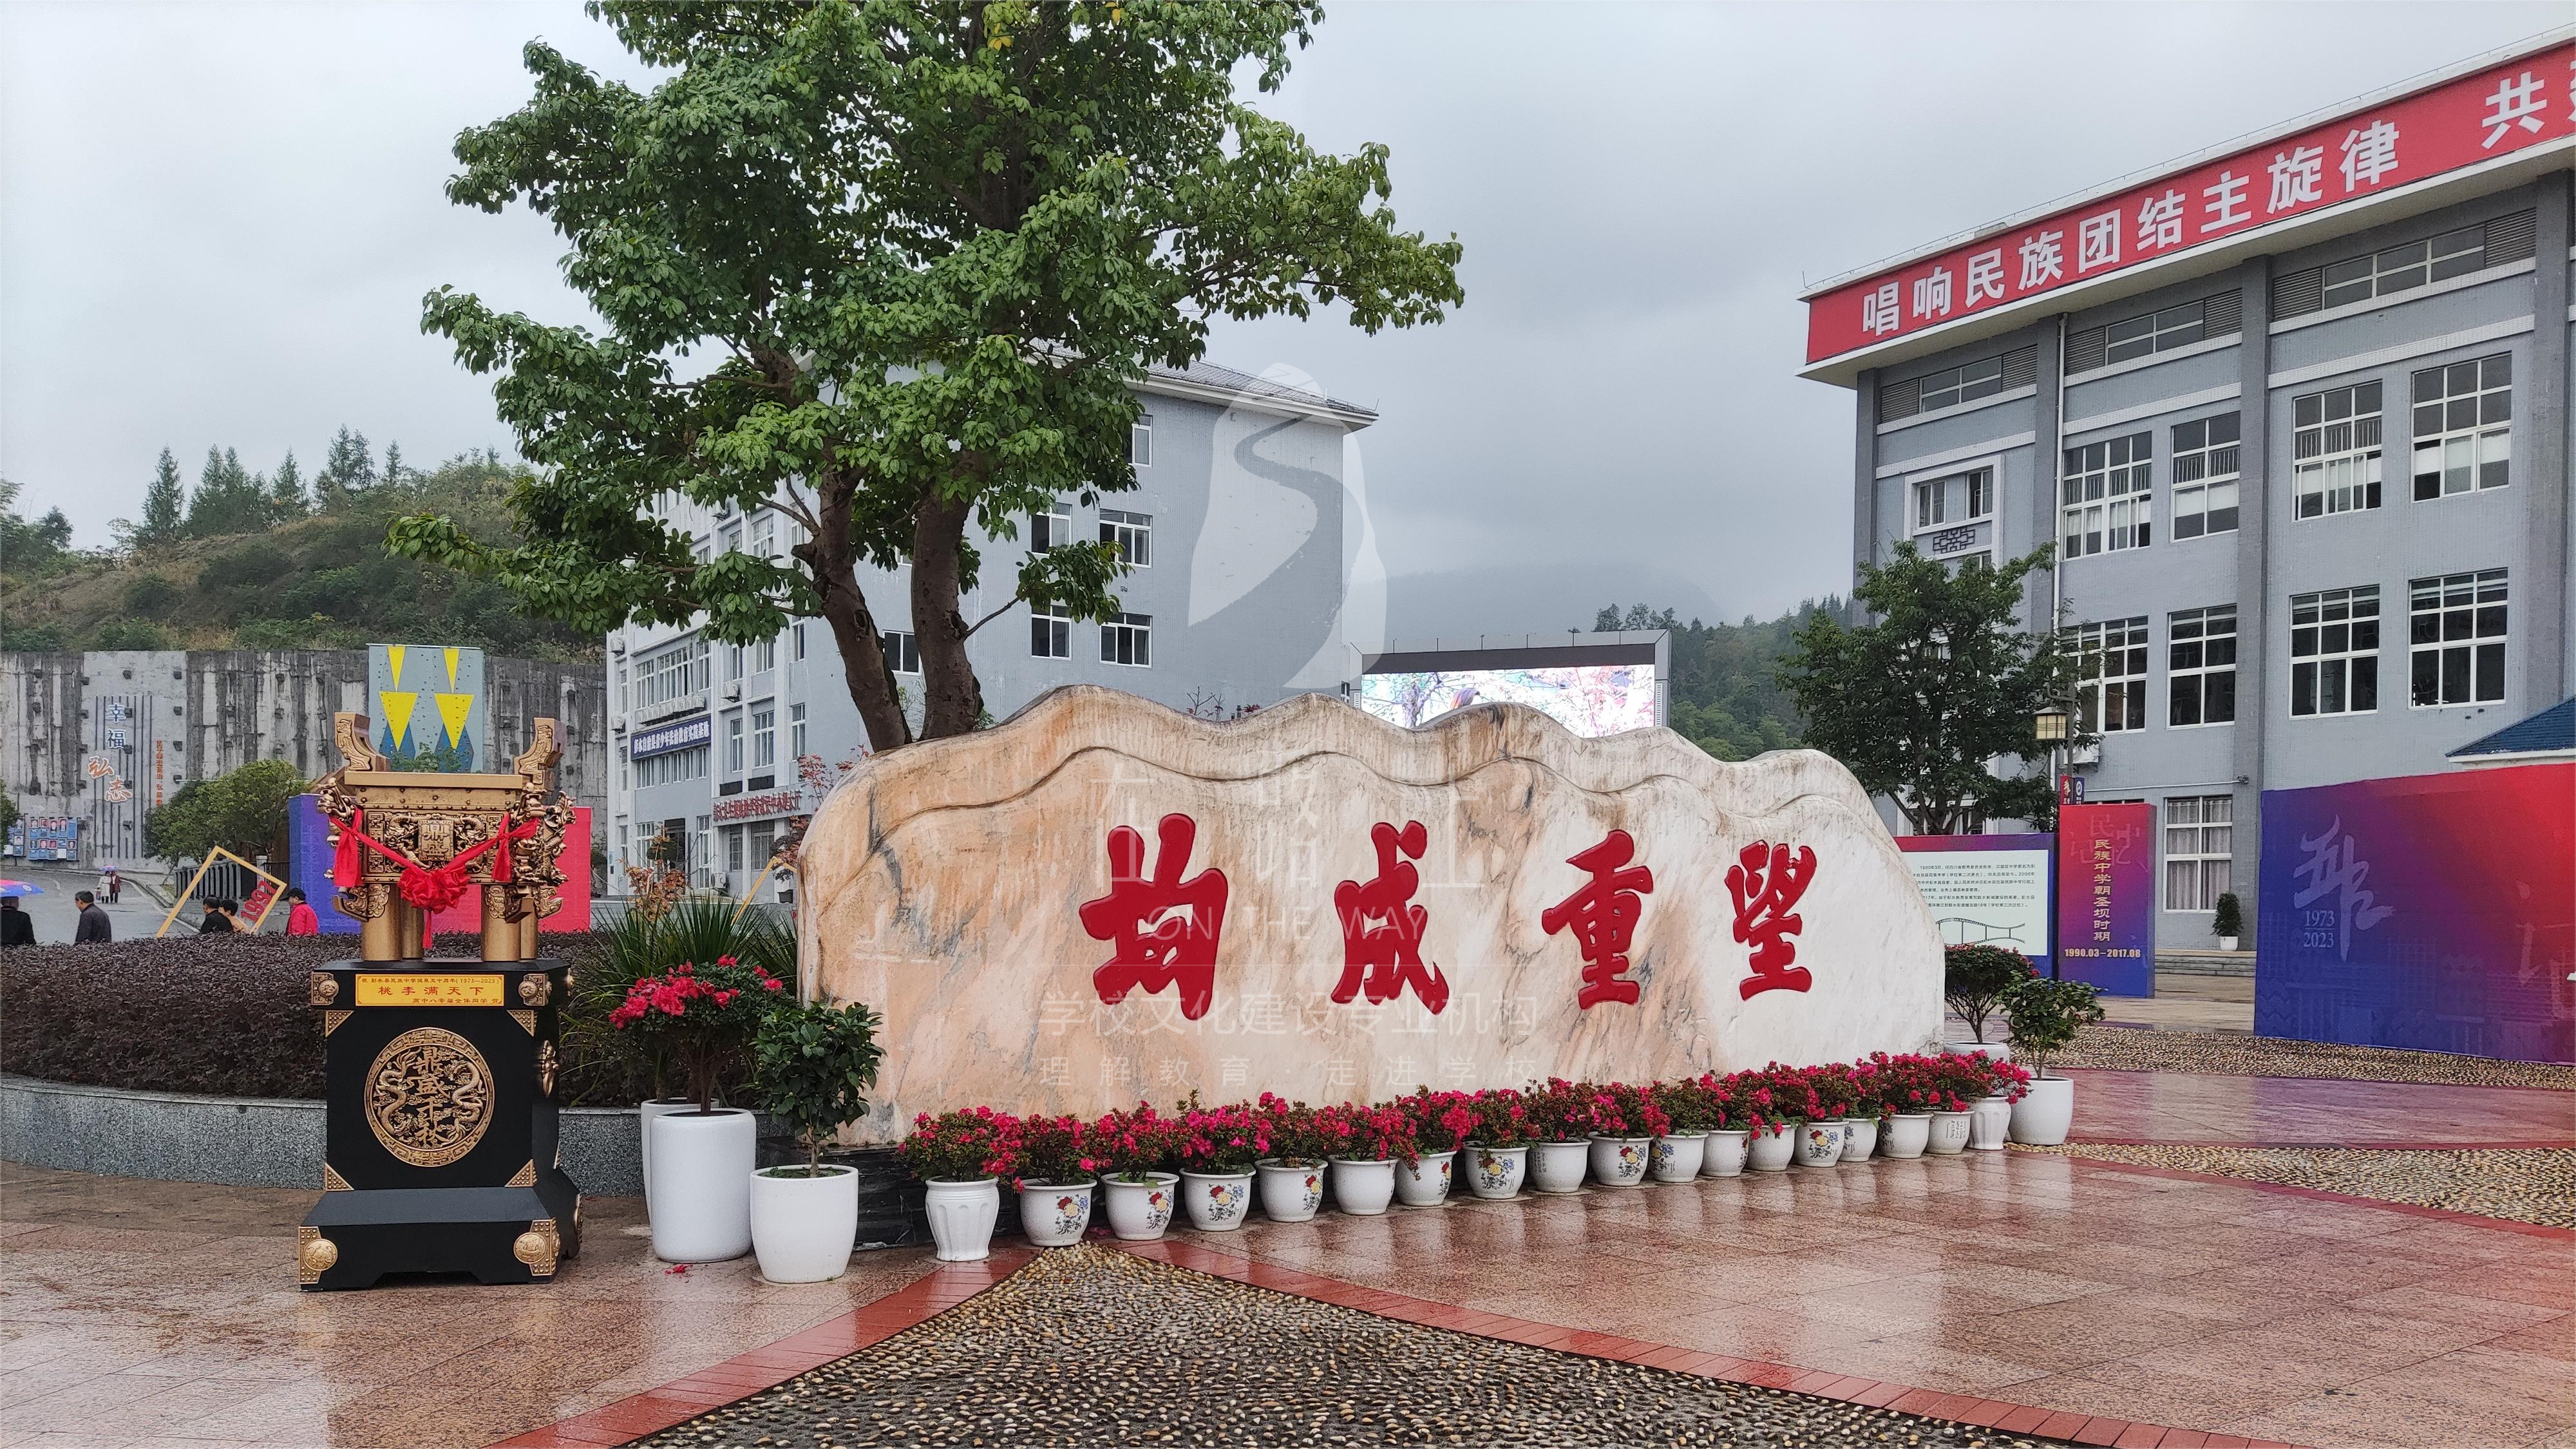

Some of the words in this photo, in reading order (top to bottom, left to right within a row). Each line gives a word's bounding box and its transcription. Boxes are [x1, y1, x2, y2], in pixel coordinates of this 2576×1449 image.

[1862, 119, 2400, 336] 唱响民族团结主旋律
[240, 880, 278, 922] 1997
[2093, 838, 2112, 942] 民族中学朝圣坝时期
[2304, 909, 2335, 927] 1973
[2302, 931, 2335, 949] 2023
[377, 986, 484, 996] 桃李满天下
[412, 1046, 451, 1147] 鼎盛千秋
